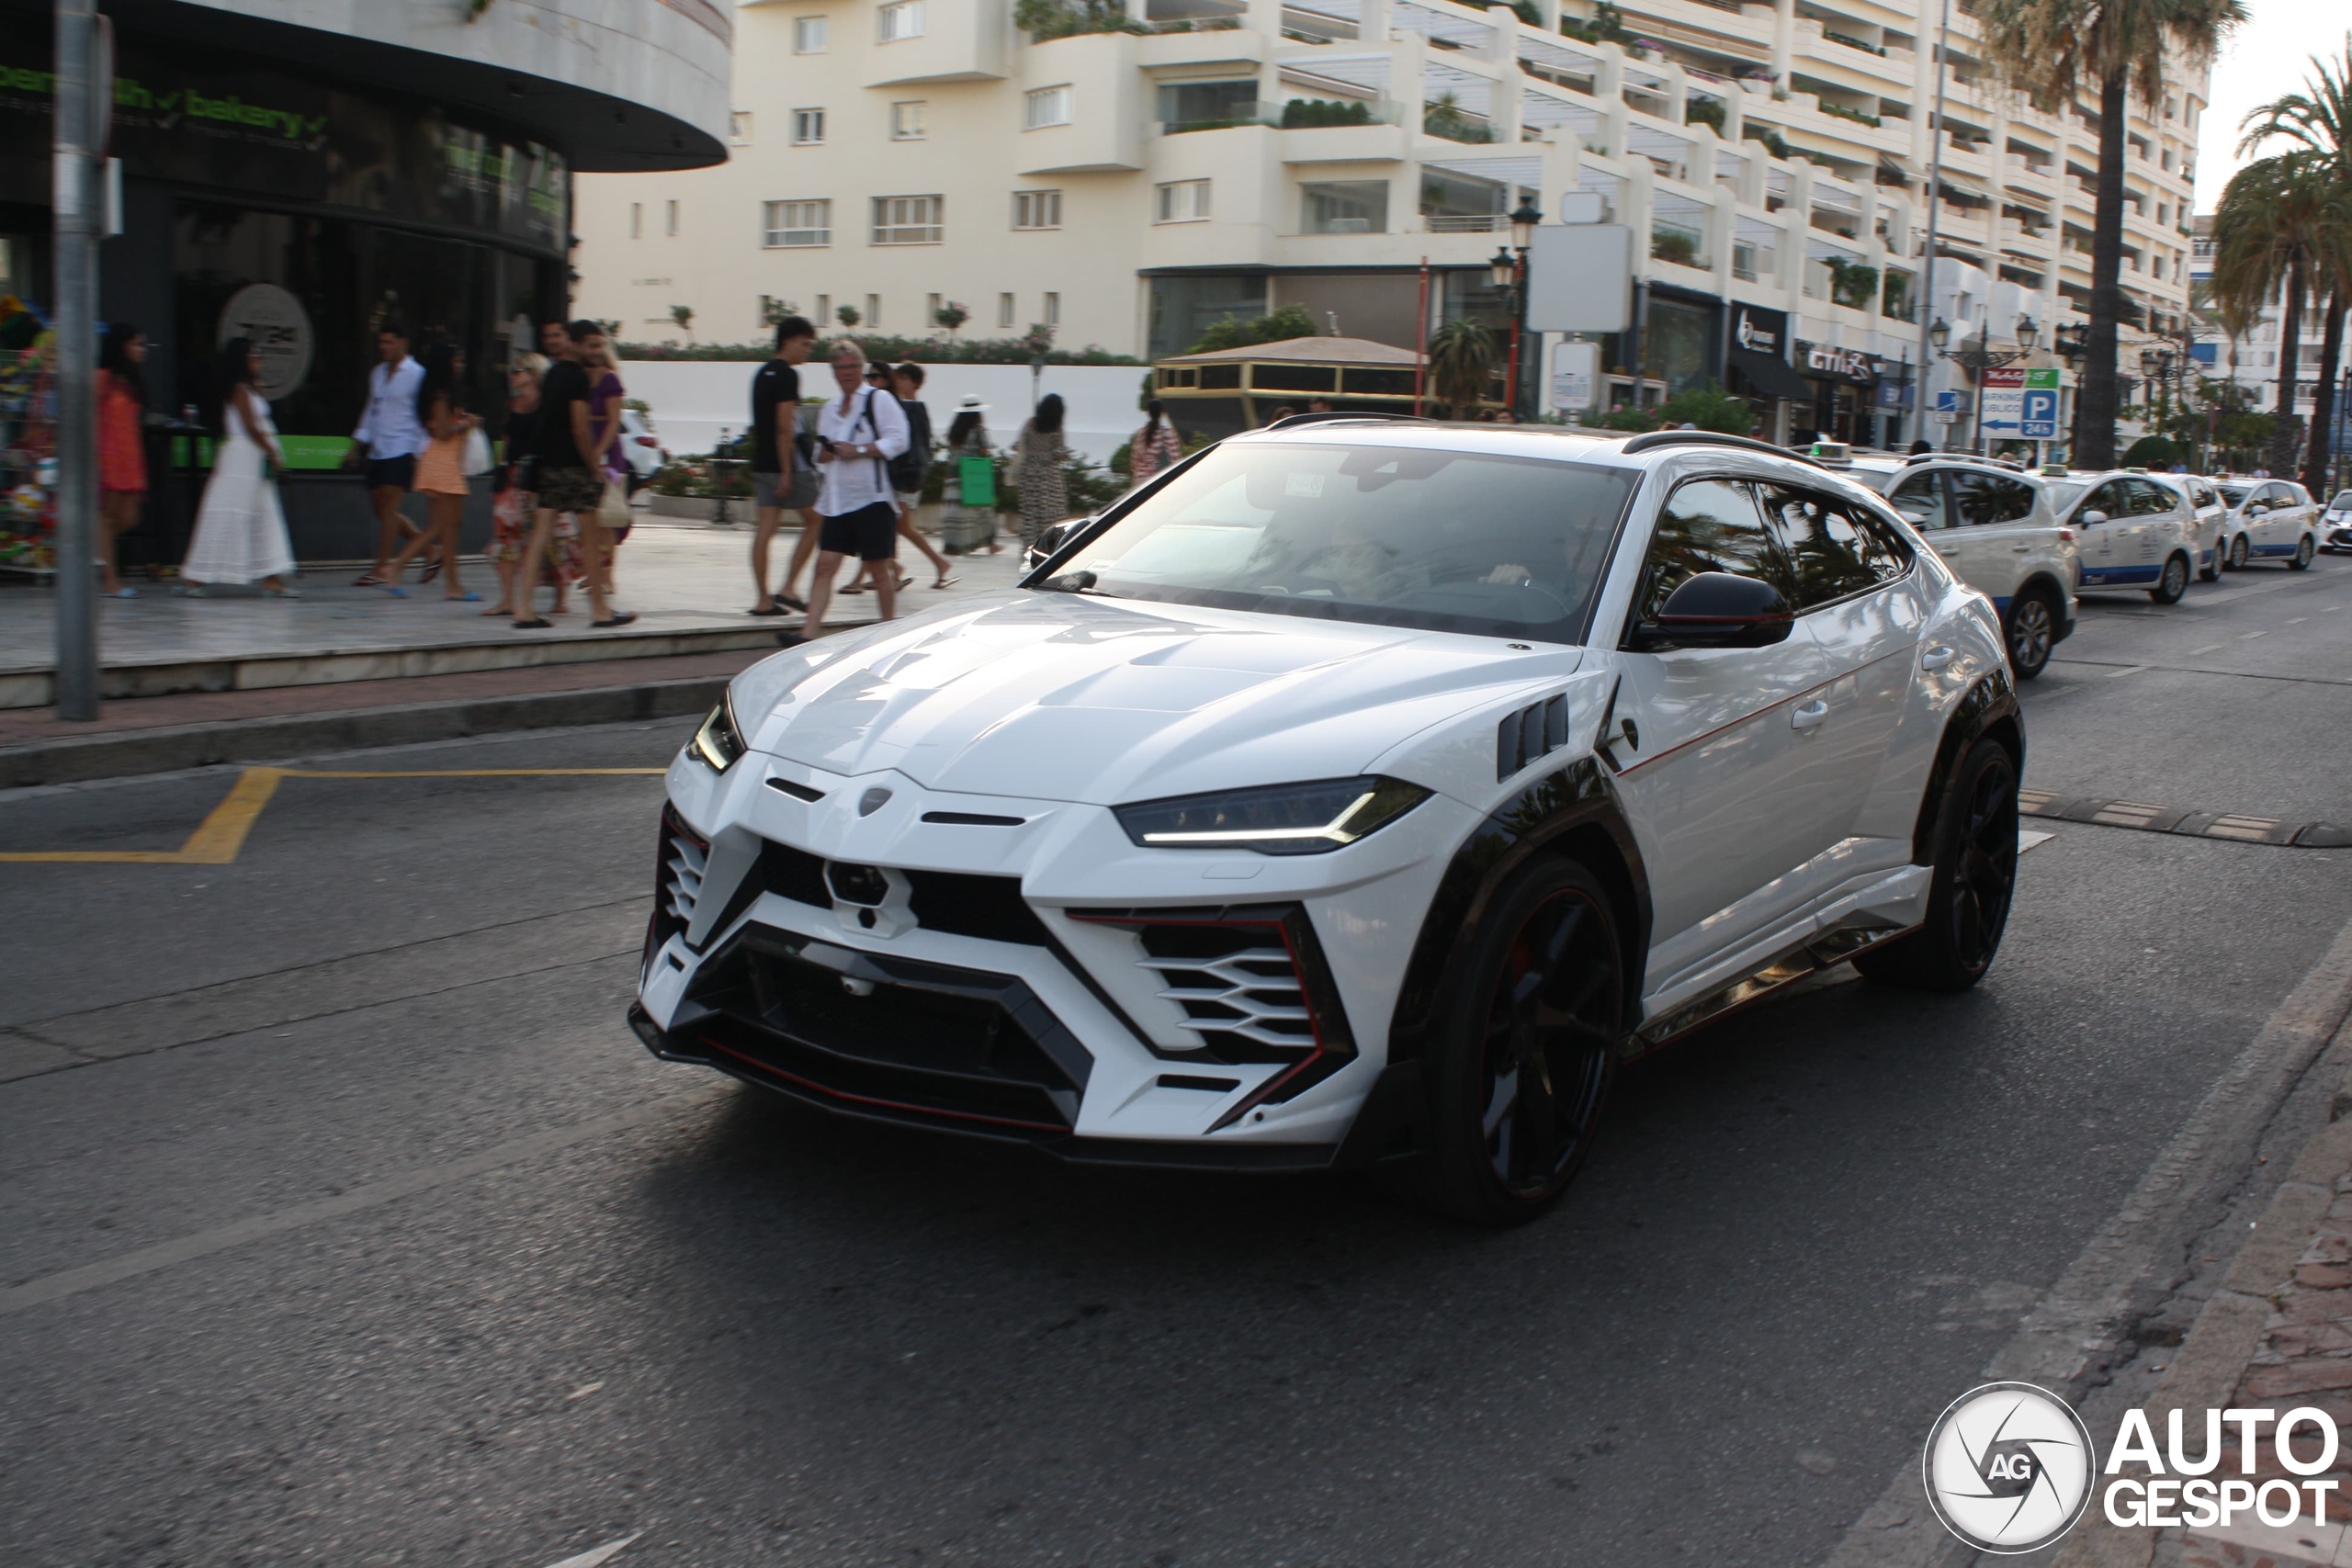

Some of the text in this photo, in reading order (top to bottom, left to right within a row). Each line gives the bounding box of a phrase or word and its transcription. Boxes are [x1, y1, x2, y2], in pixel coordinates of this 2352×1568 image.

[185, 89, 305, 139] bakery
[1983, 392, 2022, 401] ARKING
[1983, 404, 2021, 412] UBLICO
[2030, 396, 2051, 419] P
